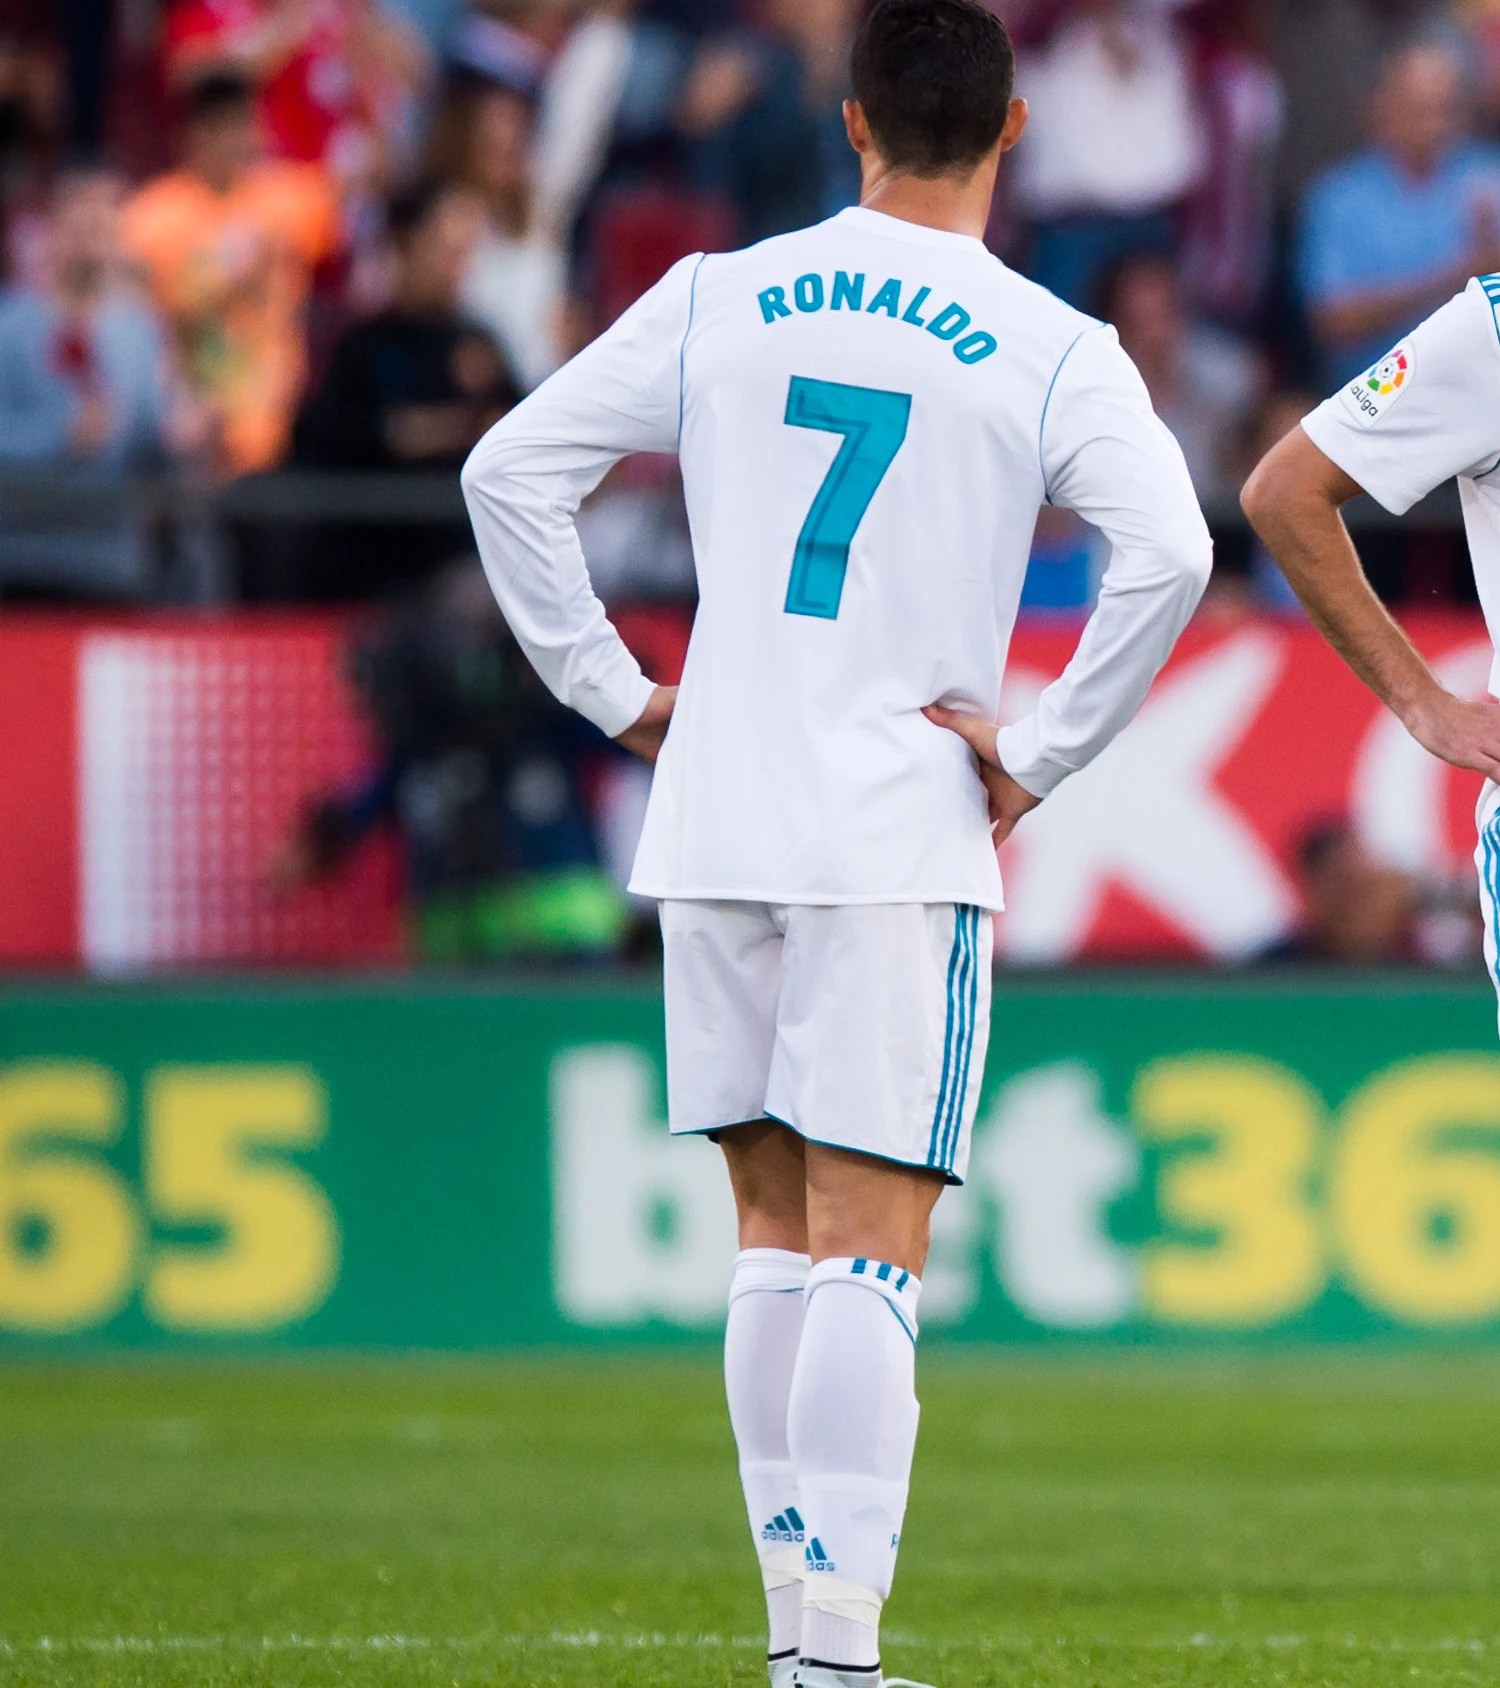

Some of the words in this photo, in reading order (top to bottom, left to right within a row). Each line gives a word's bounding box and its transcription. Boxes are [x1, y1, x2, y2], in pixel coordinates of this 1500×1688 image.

[757, 271, 997, 364] RONALDO
[1350, 385, 1378, 417] aLiga
[783, 375, 913, 620] 7
[761, 1530, 805, 1542] adida
